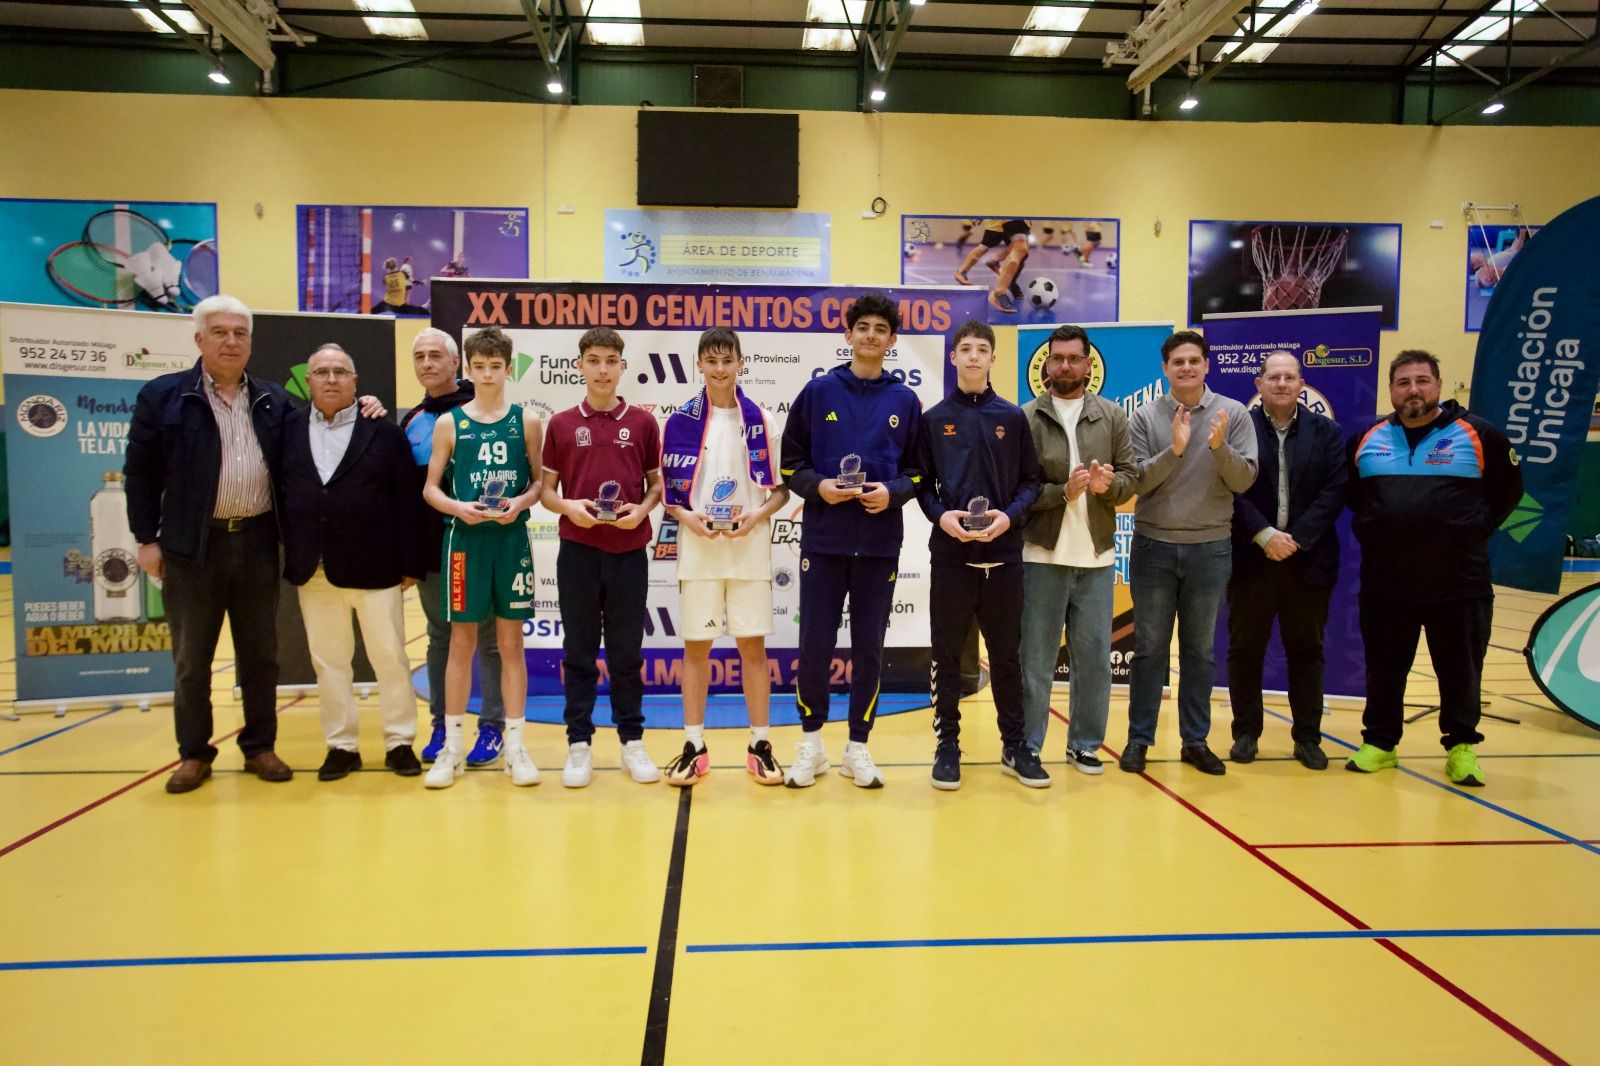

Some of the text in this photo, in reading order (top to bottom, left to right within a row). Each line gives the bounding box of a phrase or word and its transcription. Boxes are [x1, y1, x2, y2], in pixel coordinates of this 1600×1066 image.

[682, 243, 799, 257] ÁREA DE DEPORTE
[667, 268, 736, 276] AYUNTAMIENTO
[738, 269, 748, 277] DE
[467, 292, 510, 324] XX
[515, 293, 638, 326] TORNEO
[646, 294, 813, 330] CEMENTOS
[19, 346, 107, 362] 952 24 57 36
[1277, 342, 1301, 350] Málaga
[753, 354, 800, 364] Provincial
[1217, 353, 1239, 364] 952
[1242, 352, 1257, 364] 24
[1220, 365, 1261, 375] www.disge
[1505, 287, 1559, 461] undación
[1526, 339, 1586, 464] Unicaja
[78, 421, 97, 437] LA
[79, 438, 97, 454] TE
[98, 438, 117, 454] LA
[478, 441, 508, 465] 49
[662, 453, 698, 468] MVP
[470, 469, 518, 483] KA ŽALGIRIS
[778, 524, 787, 533] EL
[511, 572, 534, 596] 49
[25, 627, 56, 640] LA
[60, 623, 139, 639] MEJOR
[26, 638, 84, 656] DEL
